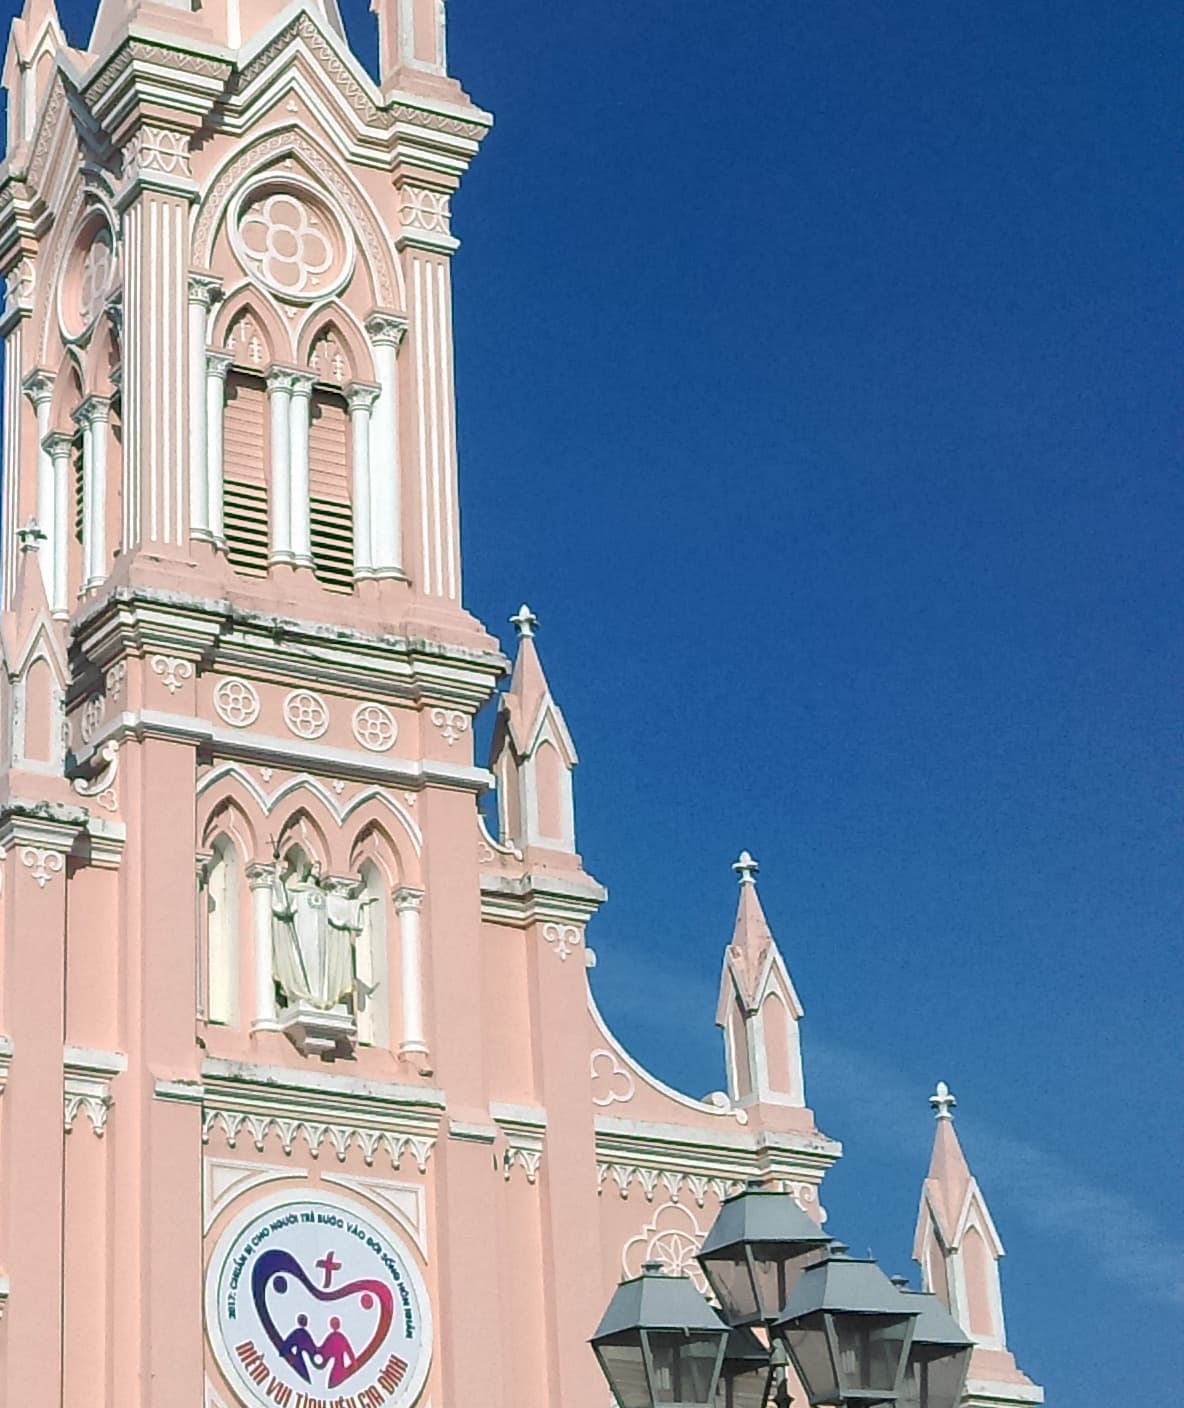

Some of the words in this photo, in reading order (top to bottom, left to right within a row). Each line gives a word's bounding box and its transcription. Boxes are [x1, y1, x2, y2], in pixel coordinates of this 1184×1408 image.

[251, 1227, 270, 1246] CHO
[346, 1221, 366, 1241] VÀO
[265, 1376, 293, 1408] VUI
